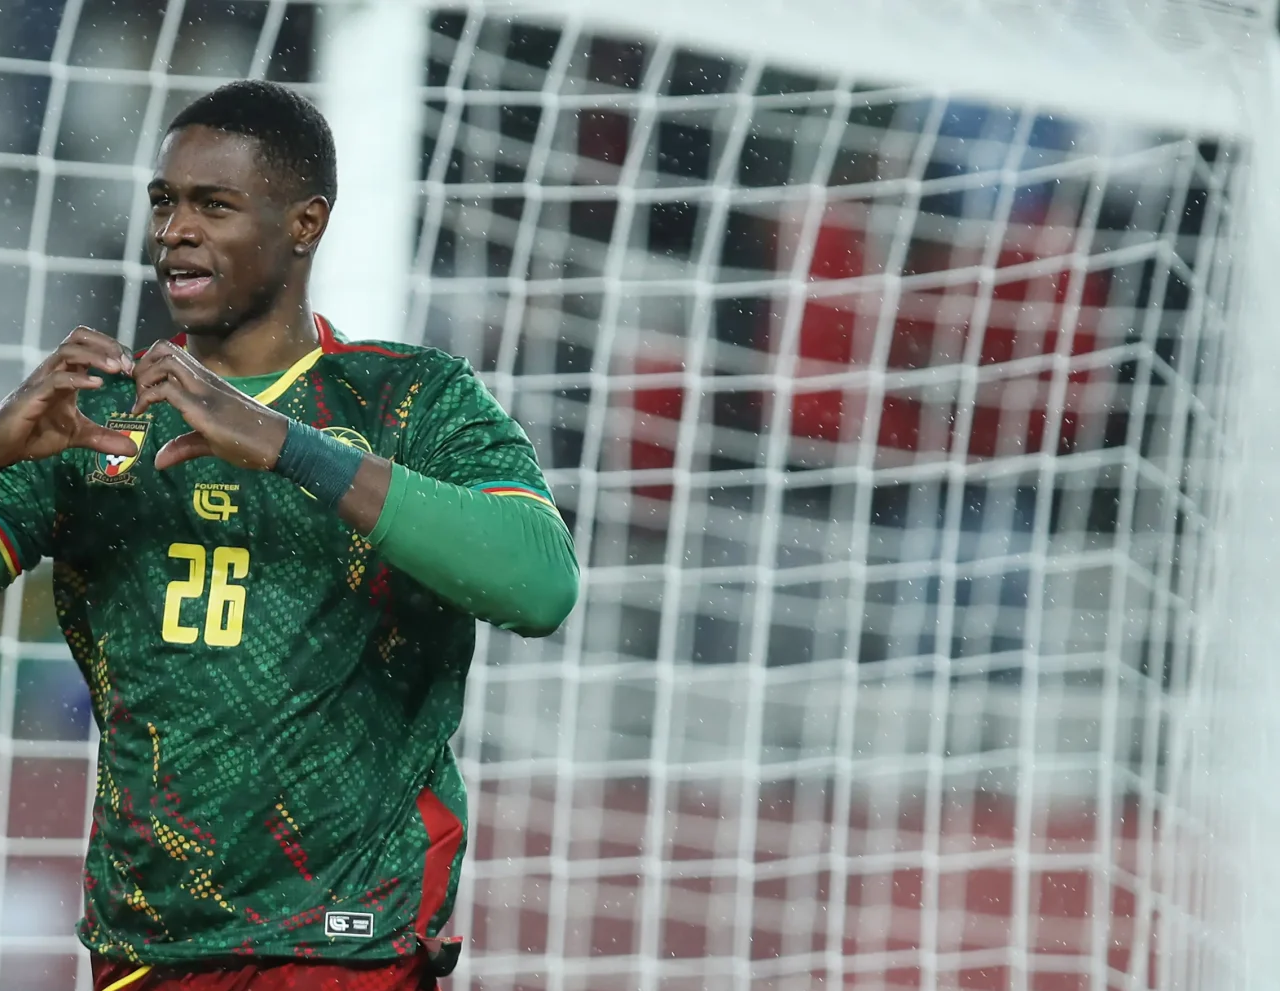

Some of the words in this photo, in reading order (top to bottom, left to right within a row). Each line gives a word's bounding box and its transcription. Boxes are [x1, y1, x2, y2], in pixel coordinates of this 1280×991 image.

[109, 422, 146, 430] CAMEROUN
[194, 482, 240, 491] FOURTEEN
[162, 542, 250, 647] 26
